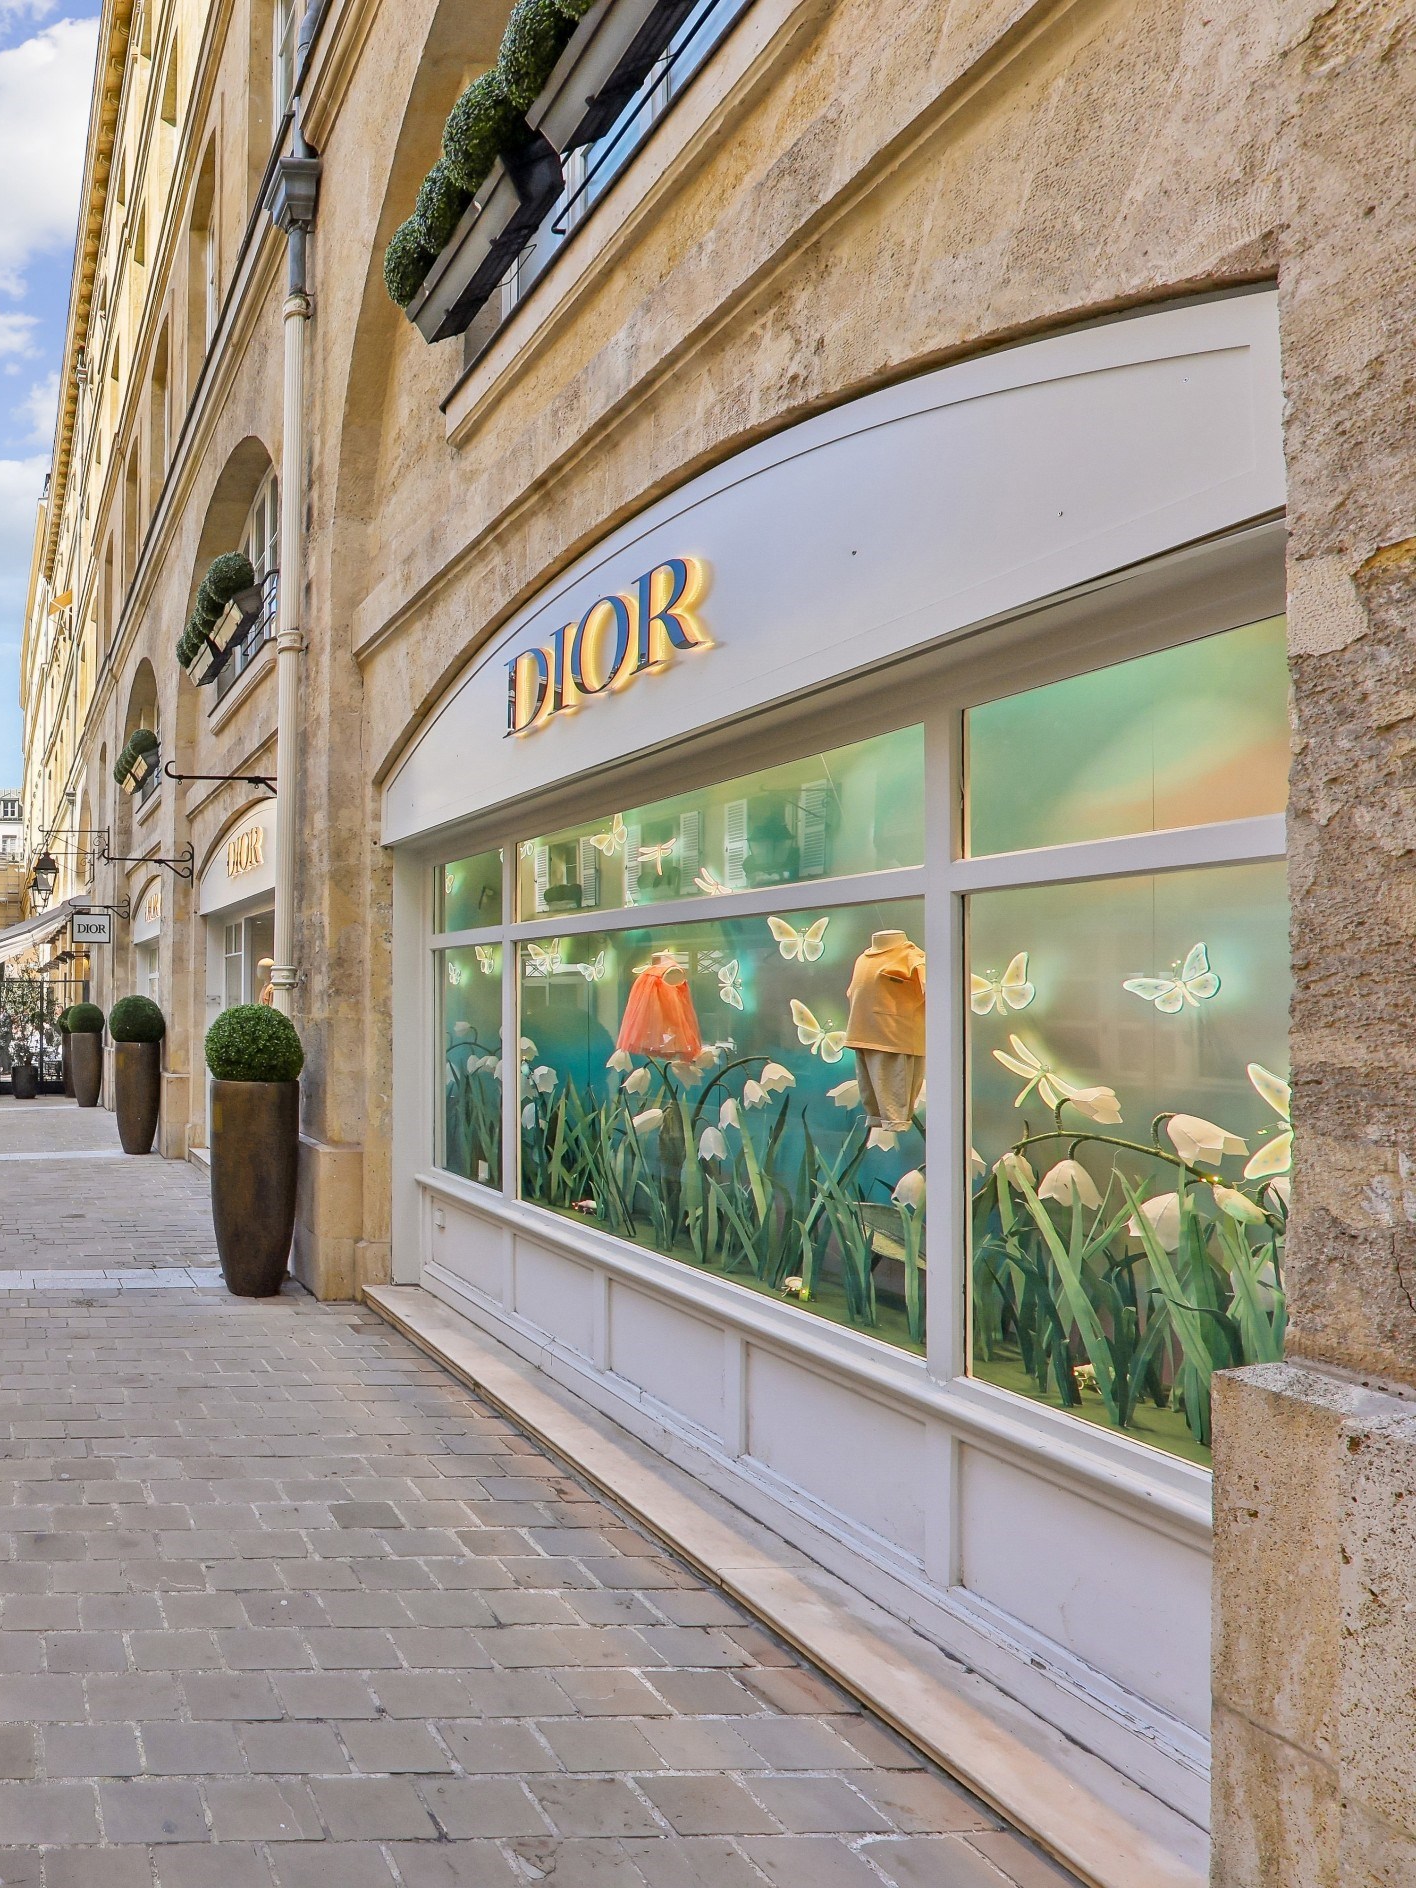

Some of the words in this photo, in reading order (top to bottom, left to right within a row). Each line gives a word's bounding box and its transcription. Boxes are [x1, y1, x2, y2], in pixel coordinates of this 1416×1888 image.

[502, 557, 714, 738] DIOR
[227, 826, 264, 878] DIOR
[77, 923, 106, 934] DIOR
